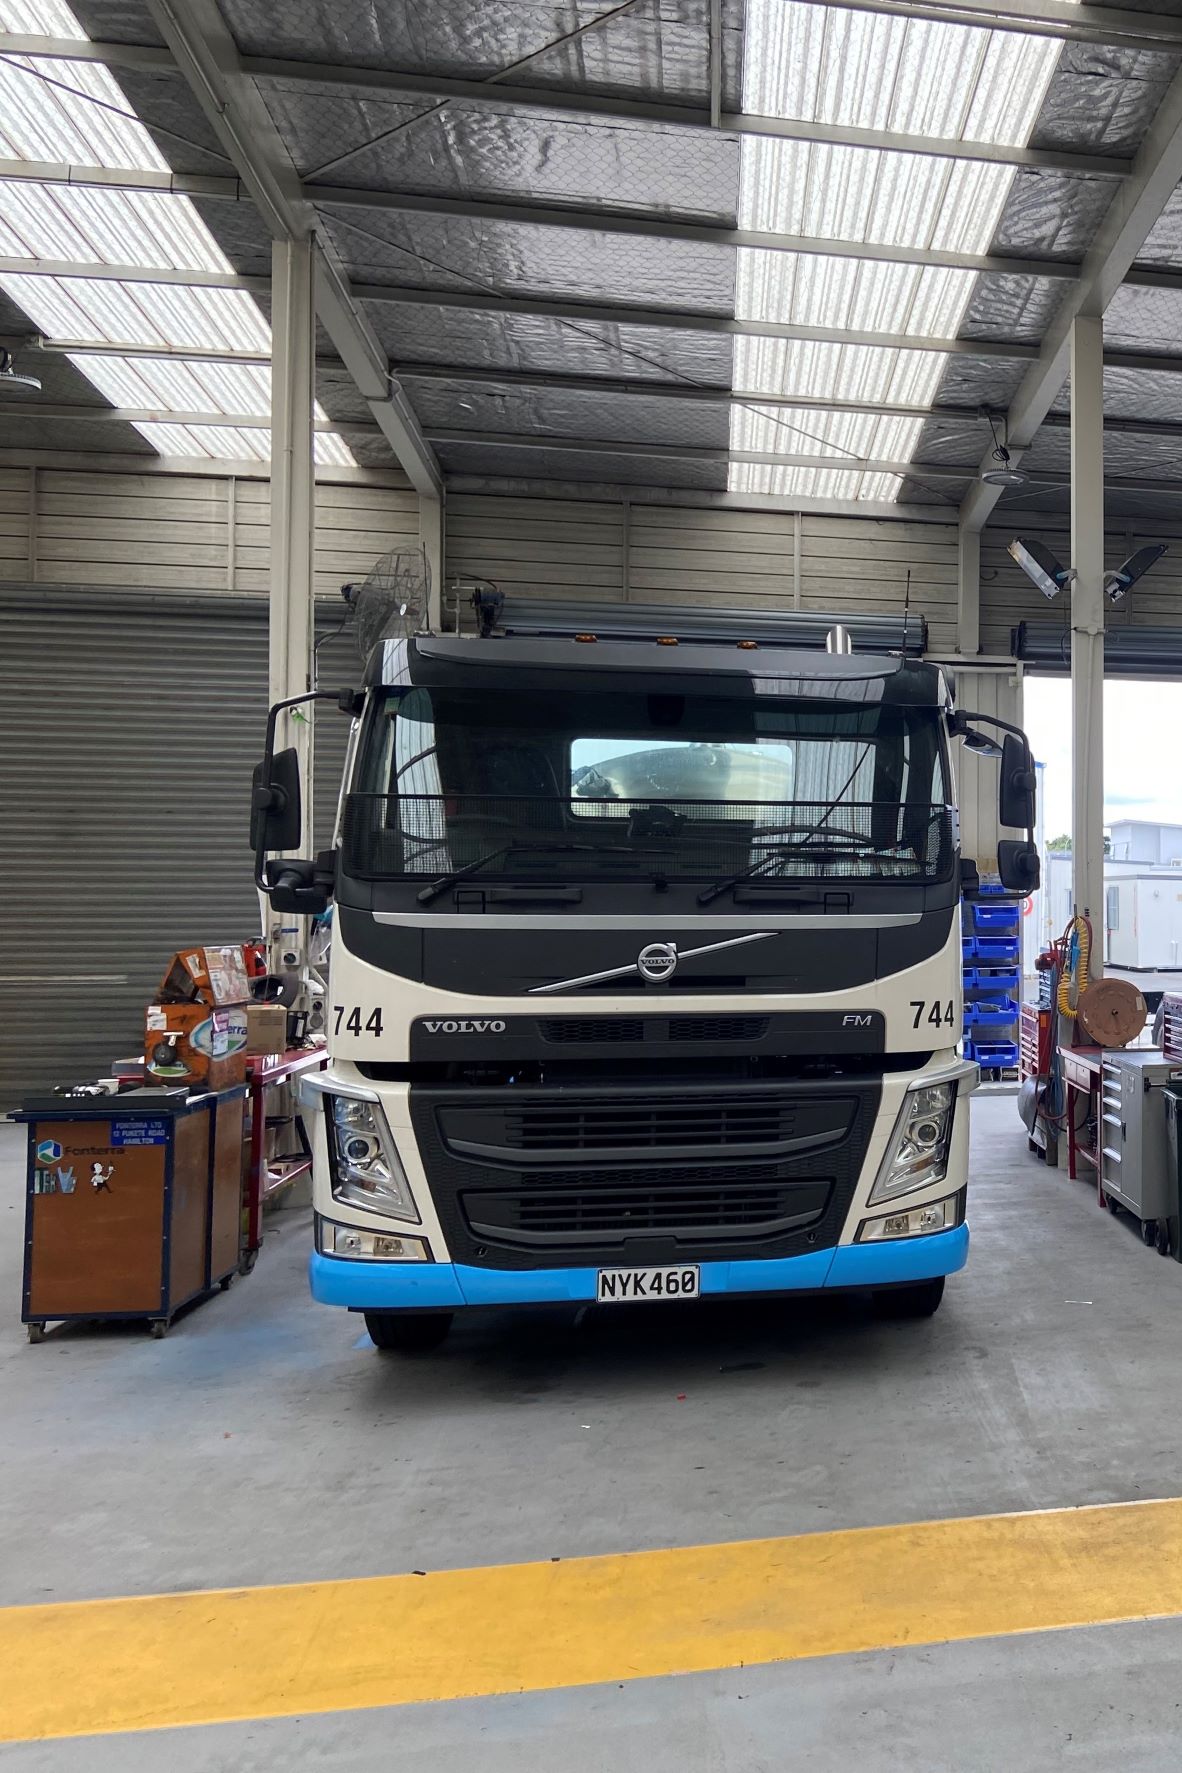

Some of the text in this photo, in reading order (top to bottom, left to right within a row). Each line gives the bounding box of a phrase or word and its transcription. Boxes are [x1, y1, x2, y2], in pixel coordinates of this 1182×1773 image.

[334, 1005, 384, 1037] 744
[422, 1020, 506, 1033] VOLVO
[842, 1015, 872, 1026] FM
[909, 1000, 955, 1029] 744
[601, 1270, 696, 1298] NYK460
